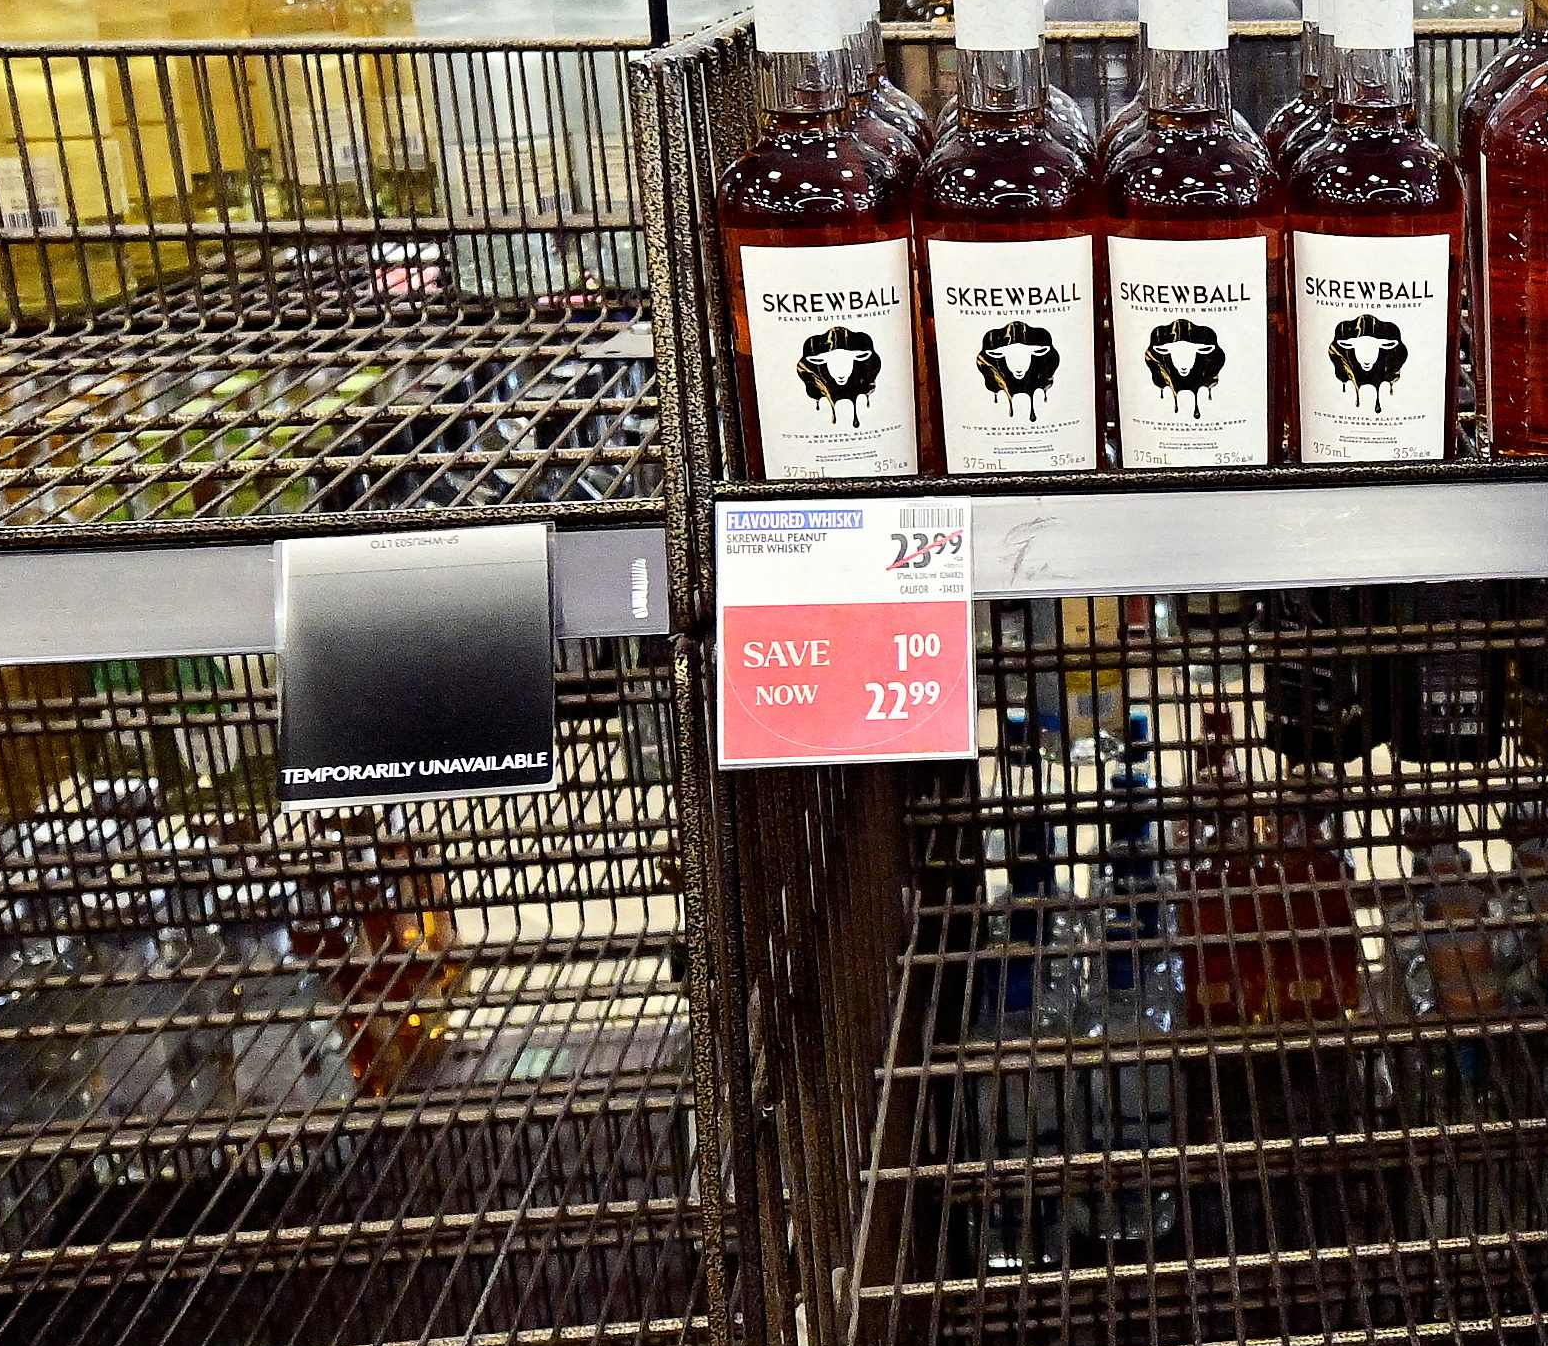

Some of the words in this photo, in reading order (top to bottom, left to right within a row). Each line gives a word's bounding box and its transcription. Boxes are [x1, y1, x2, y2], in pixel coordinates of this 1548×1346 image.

[946, 283, 1081, 307] SKREWBALL
[1120, 281, 1251, 305] SKREWBALL
[1305, 276, 1434, 300] SKREWBALL
[762, 285, 900, 314] SKREWBALL
[1133, 449, 1172, 465] 375mL
[1312, 441, 1352, 458] 375mL
[963, 457, 1007, 471] 375mL
[727, 511, 805, 530] FLAVOURED
[808, 510, 862, 529] WHISKY
[726, 533, 785, 543] SKREWBALL
[787, 532, 828, 542] PEANUT
[726, 544, 764, 554] BUTTER
[767, 543, 812, 554] WHISKEY
[743, 640, 830, 668] SAVE
[755, 685, 818, 705] NOW
[281, 760, 414, 785] TEMPORARILY
[419, 752, 548, 776] UNAVAILABLE
